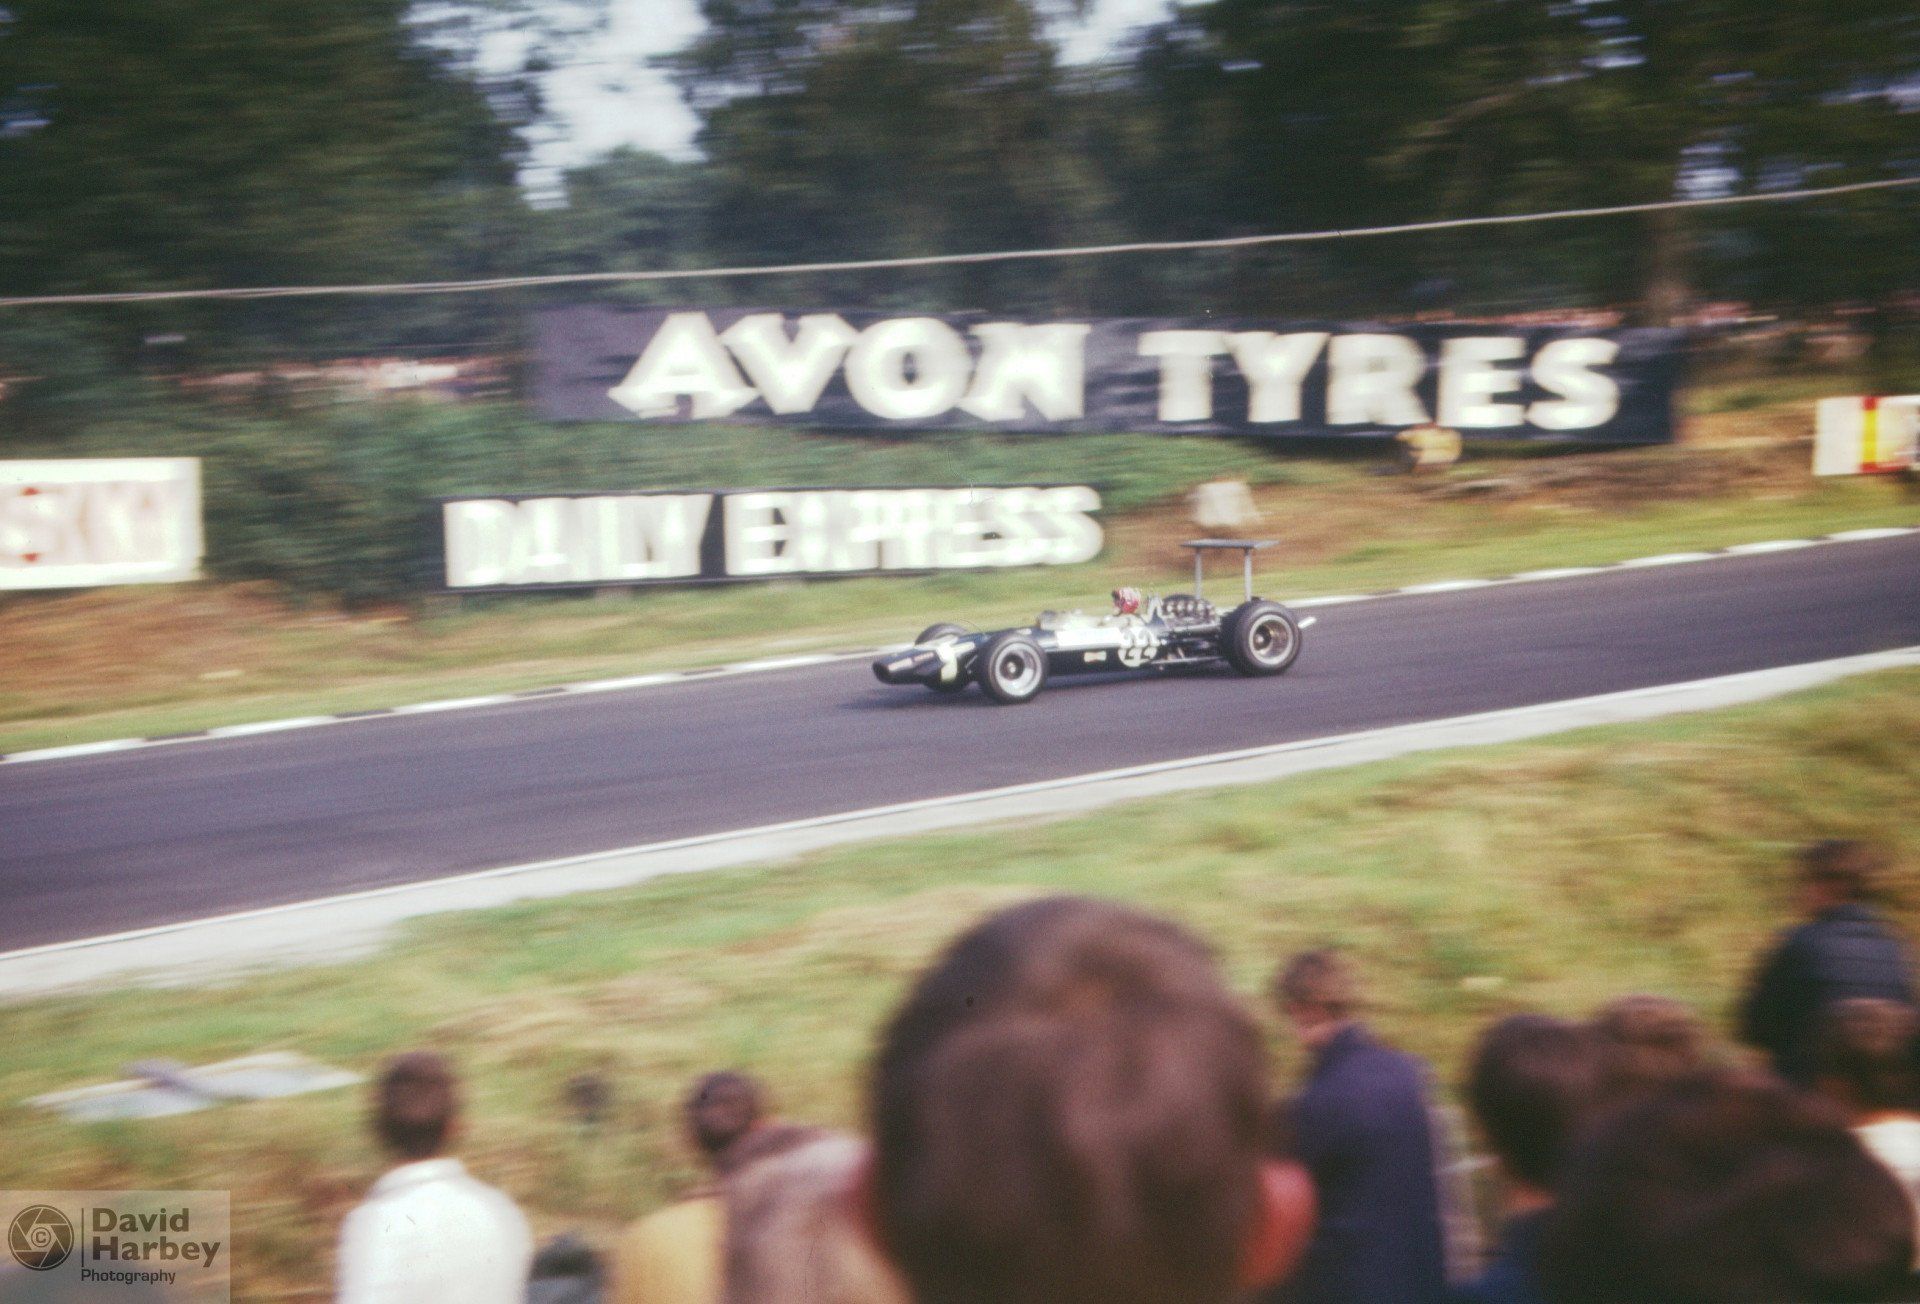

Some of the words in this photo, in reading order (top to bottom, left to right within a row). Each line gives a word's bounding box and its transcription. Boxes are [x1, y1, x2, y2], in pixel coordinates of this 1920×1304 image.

[606, 311, 1094, 422] AVON
[1136, 329, 1621, 431] TYRES
[443, 494, 714, 587] DAILY
[723, 485, 1105, 576] EXPRESS
[1123, 629, 1152, 660] 22
